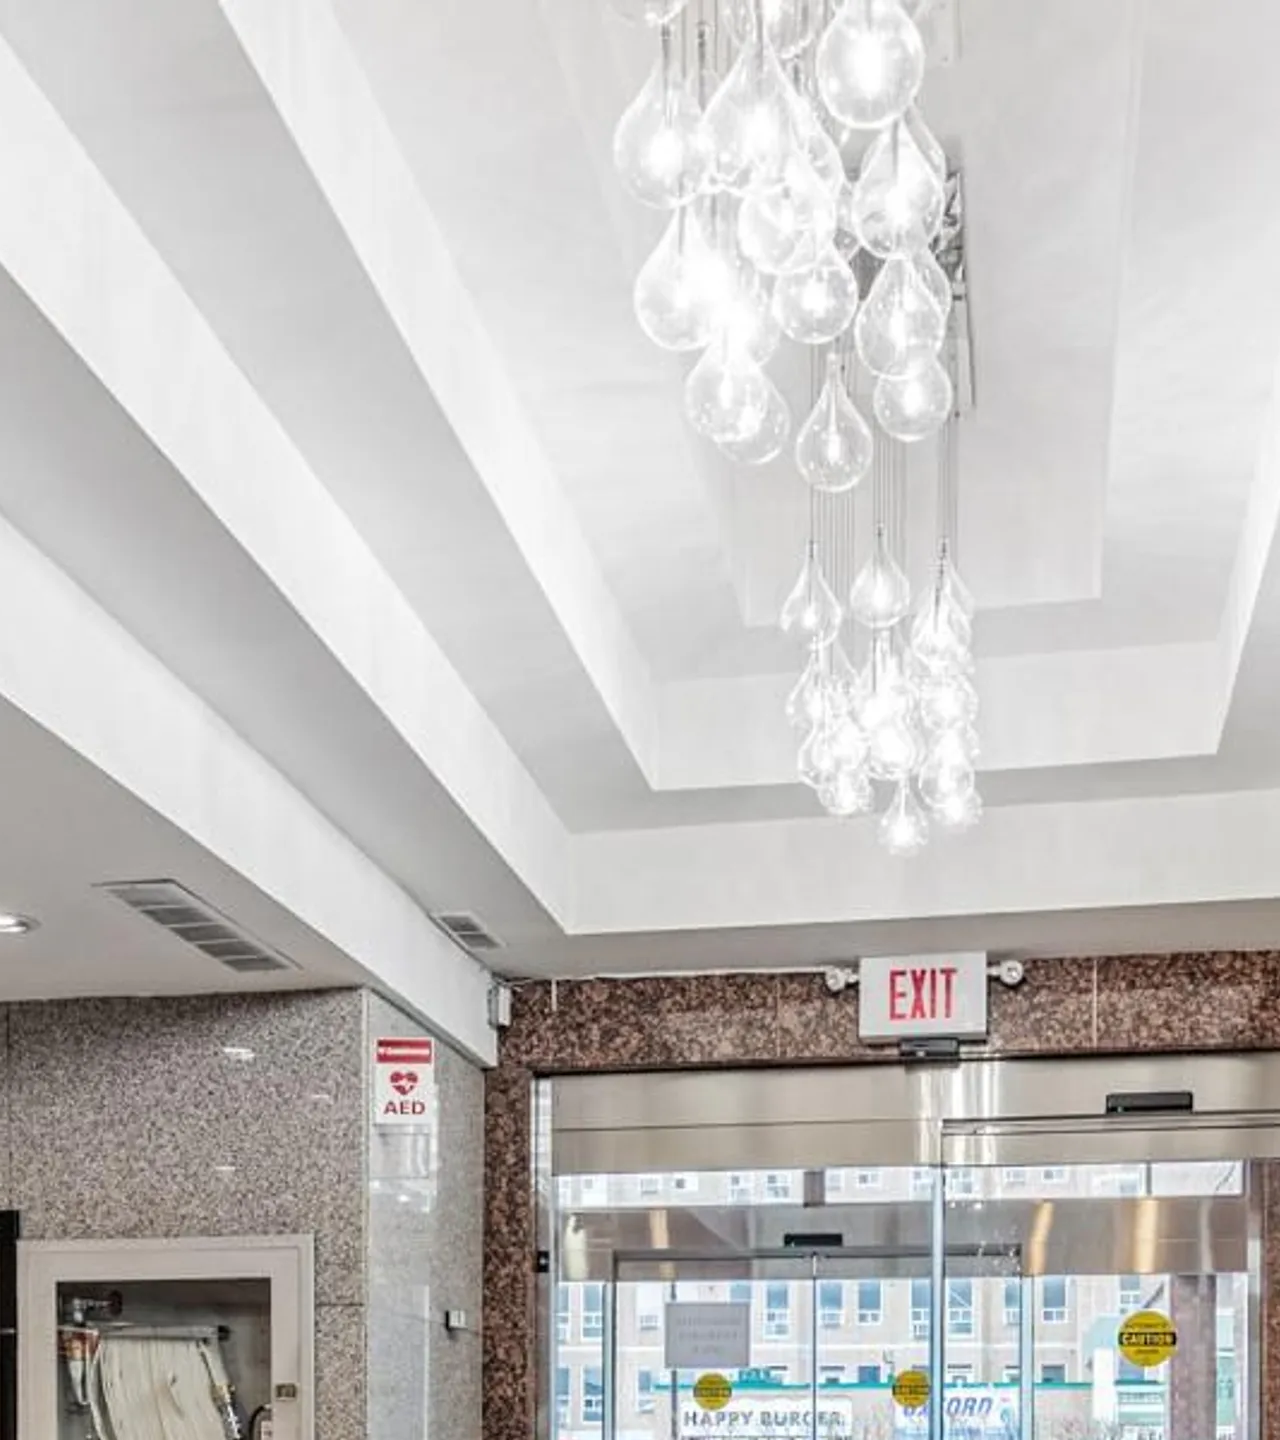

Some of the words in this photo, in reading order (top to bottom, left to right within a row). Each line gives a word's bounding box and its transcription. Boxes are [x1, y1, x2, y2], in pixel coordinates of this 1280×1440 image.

[889, 968, 958, 1020] EXIT
[383, 1100, 425, 1115] AED
[683, 1411, 754, 1426] HAPPY
